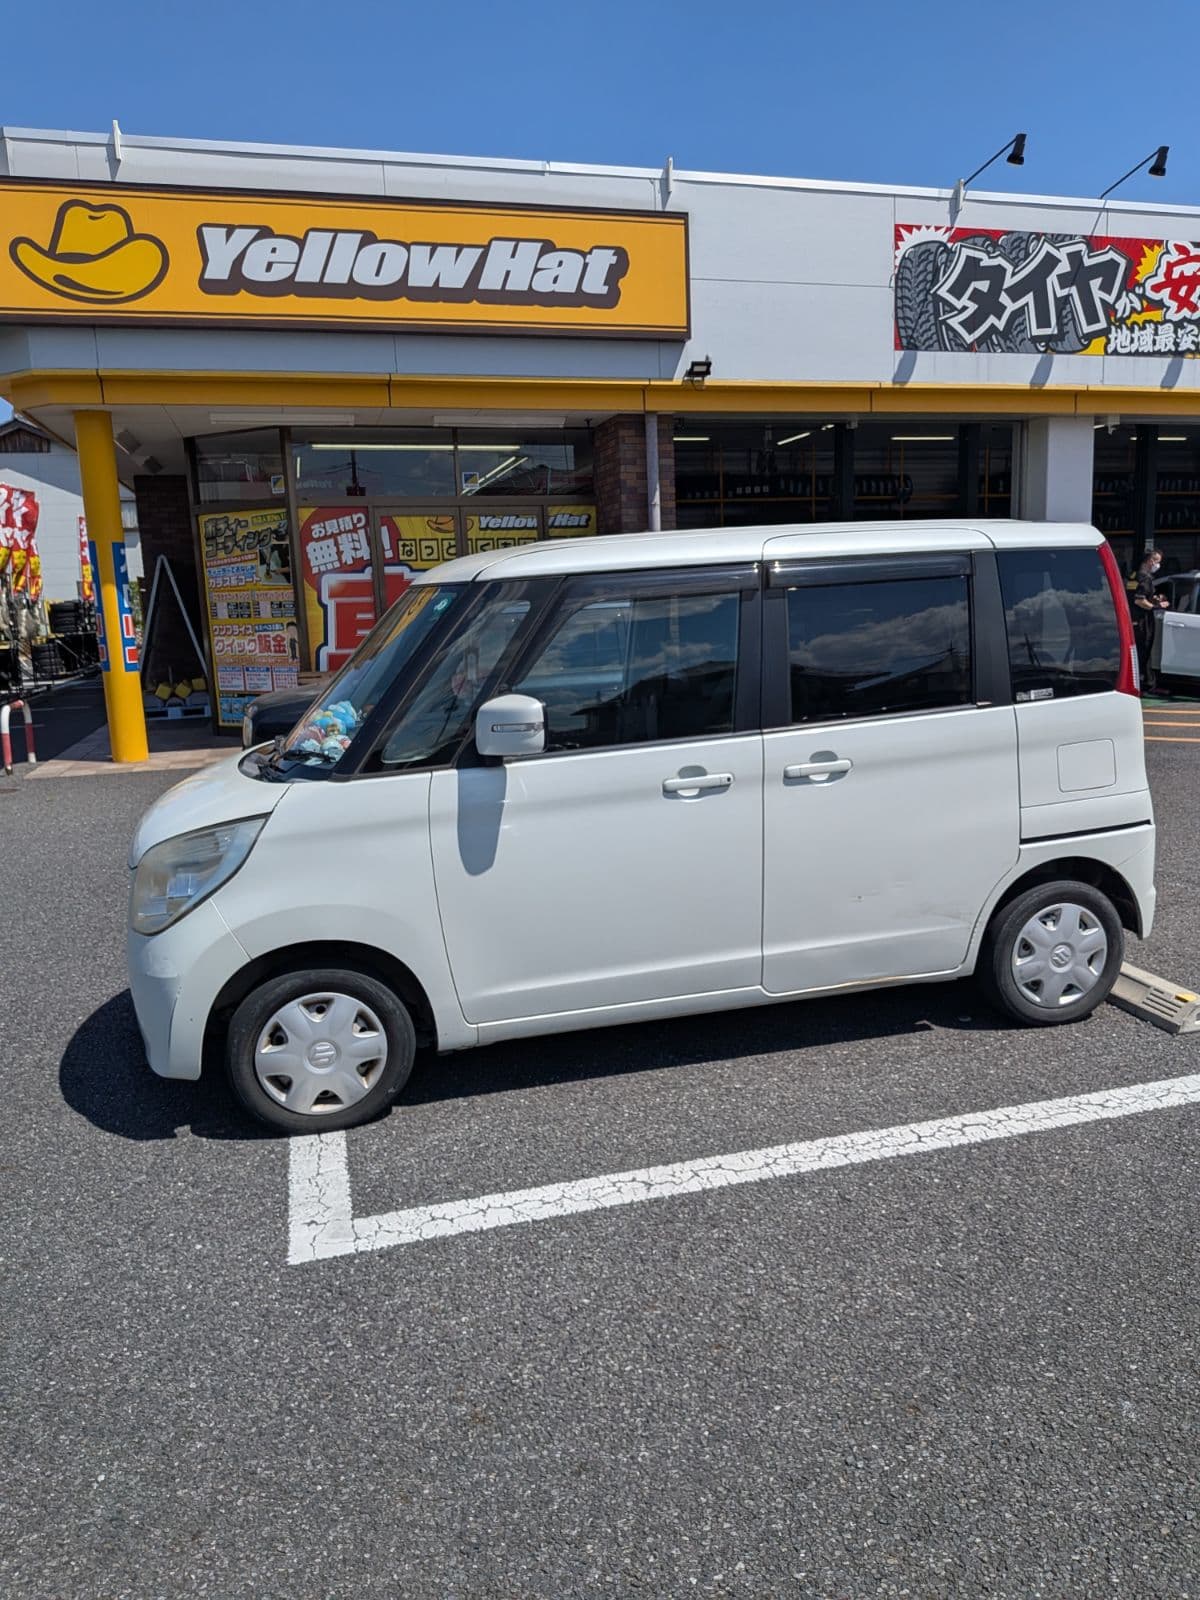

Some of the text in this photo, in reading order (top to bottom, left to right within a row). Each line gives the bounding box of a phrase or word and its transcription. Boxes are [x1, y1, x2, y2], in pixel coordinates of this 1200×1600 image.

[199, 225, 621, 299] YellowHat
[1106, 323, 1200, 354] 地域最安
